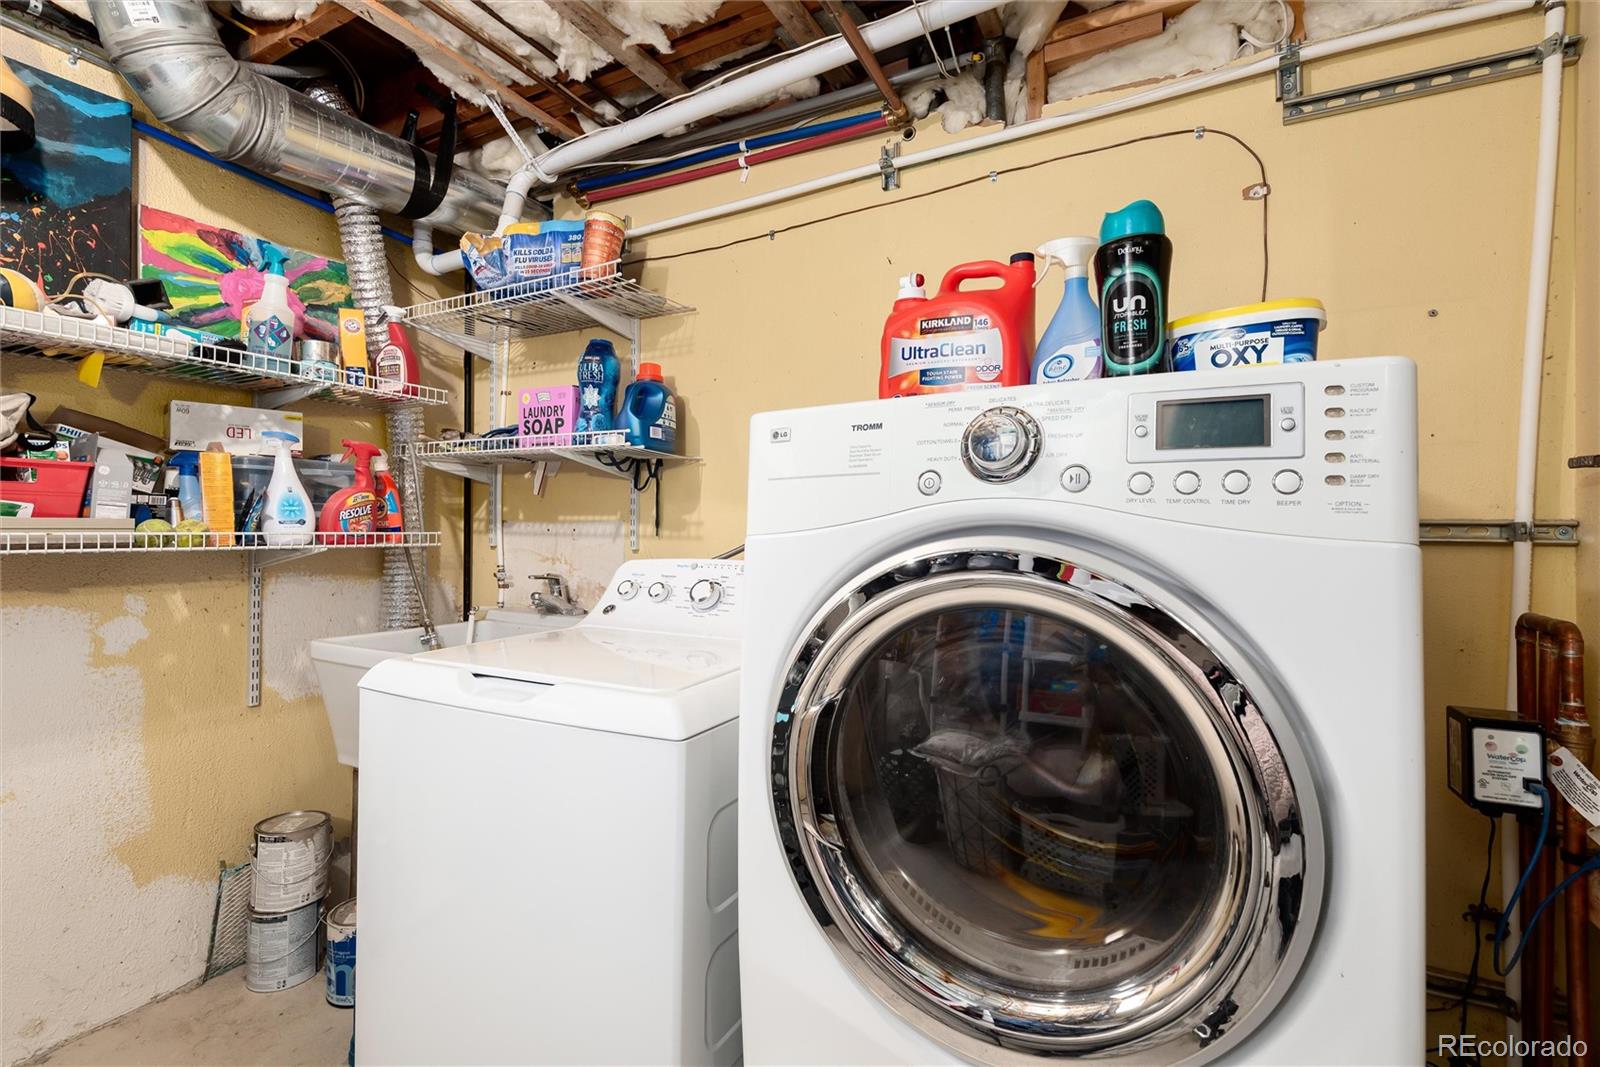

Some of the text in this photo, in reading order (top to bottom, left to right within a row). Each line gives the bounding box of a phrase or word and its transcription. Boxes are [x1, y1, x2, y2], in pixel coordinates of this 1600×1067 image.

[513, 248, 532, 256] KILLS
[532, 247, 548, 256] COLD
[528, 255, 553, 264] VIRUSES
[921, 316, 972, 330] KIRKLAND
[974, 318, 988, 327] 146
[1114, 319, 1148, 334] FRESH
[1210, 337, 1270, 351] MULTI-PURPOSE
[901, 342, 986, 361] UltraClean
[1210, 344, 1270, 368] OXY
[580, 362, 604, 372] ULTRA
[976, 364, 1001, 372] ODOR
[579, 371, 604, 381] FRESH
[523, 404, 566, 419] LAUNDRY
[226, 426, 252, 440] LED
[523, 418, 565, 436] SOAP
[851, 422, 883, 432] TROMM
[339, 504, 372, 520] RESOLVE
[1486, 752, 1526, 764] WaterCop
